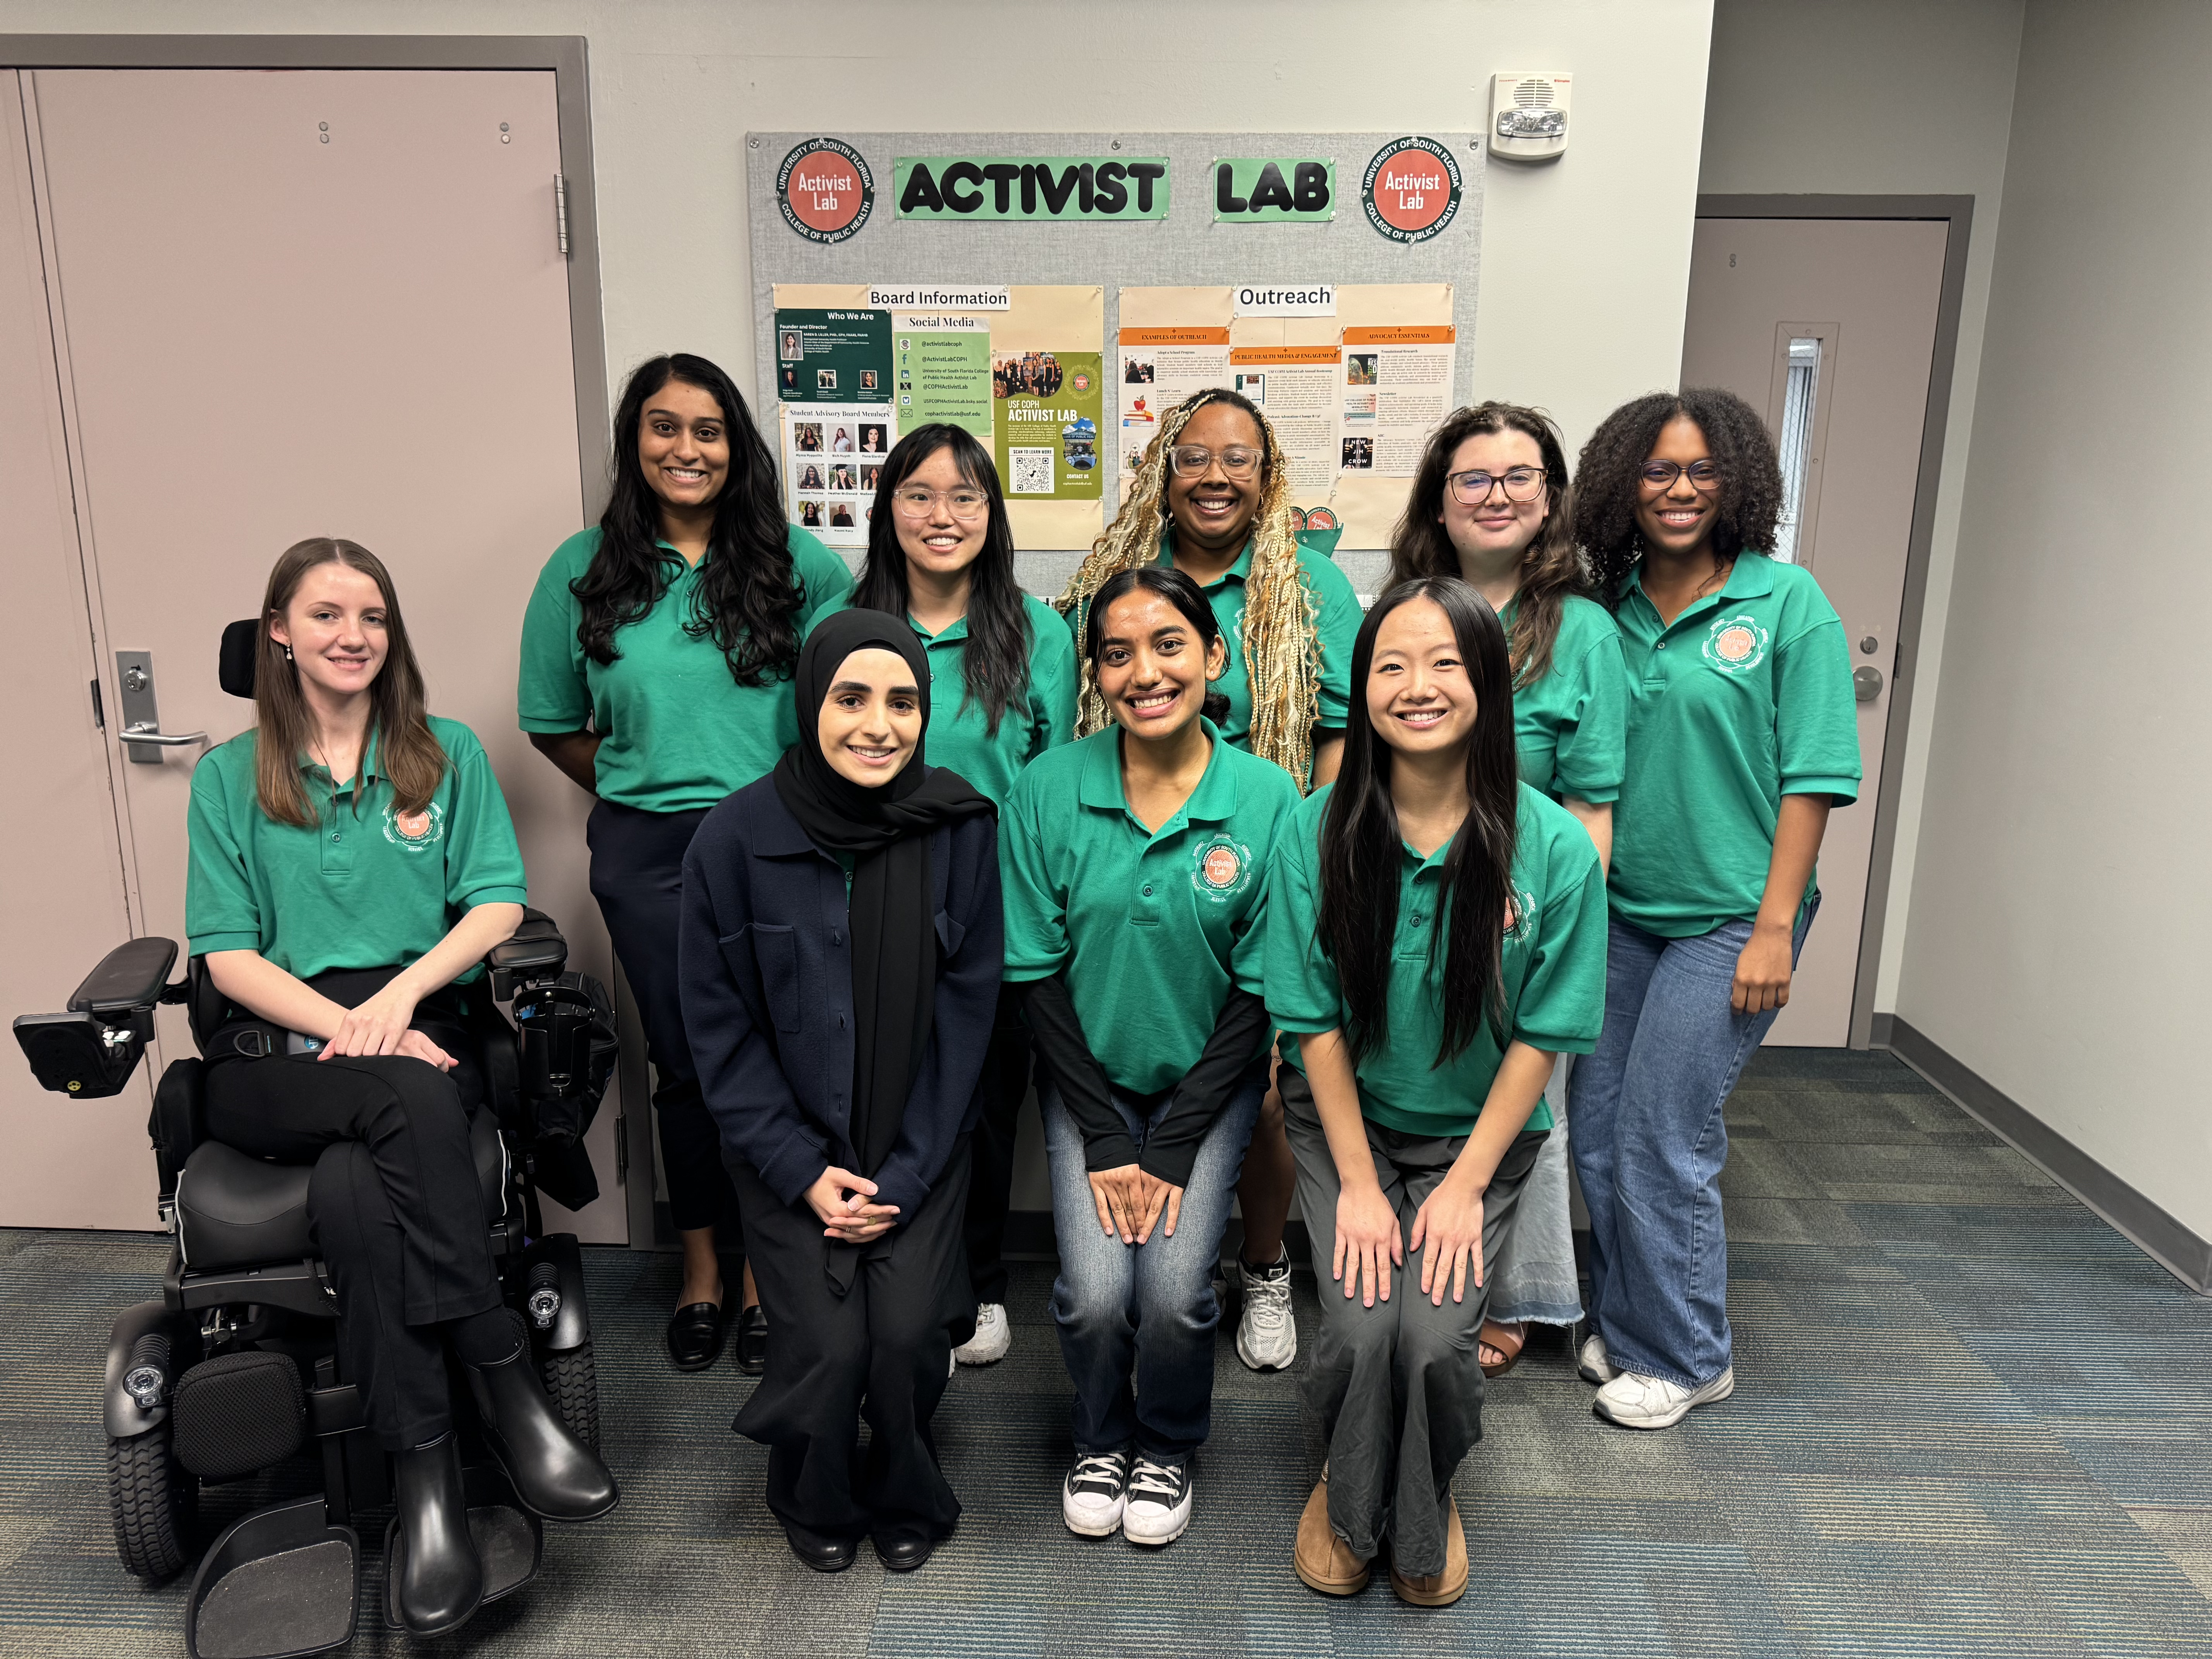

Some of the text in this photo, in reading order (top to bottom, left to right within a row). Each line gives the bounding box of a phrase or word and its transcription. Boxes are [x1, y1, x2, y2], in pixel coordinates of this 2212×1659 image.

[779, 141, 871, 189] UNIVERSITY OF SOUTH FLORIDA
[1365, 140, 1460, 188] UNIVERSITY OF SOUTH FLORIDA
[799, 173, 852, 191] Activist
[900, 161, 1329, 215] ACTIVIST LAB
[1385, 171, 1439, 190] Activist
[814, 192, 837, 210] Lab
[1400, 191, 1424, 209] Lab
[782, 201, 870, 241] COLLEGE OF PUBLIC HEALTH
[1366, 201, 1457, 240] COLLEGE OF PUBLIC HEALTH
[871, 291, 1007, 304] Board Information
[1240, 287, 1330, 304] Outreach
[910, 317, 974, 327] Social Media
[1008, 400, 1039, 409] USF COPH
[1008, 409, 1077, 421] ACTIVIST LAB
[1209, 858, 1231, 867] Activist
[1214, 867, 1226, 875] Lab
